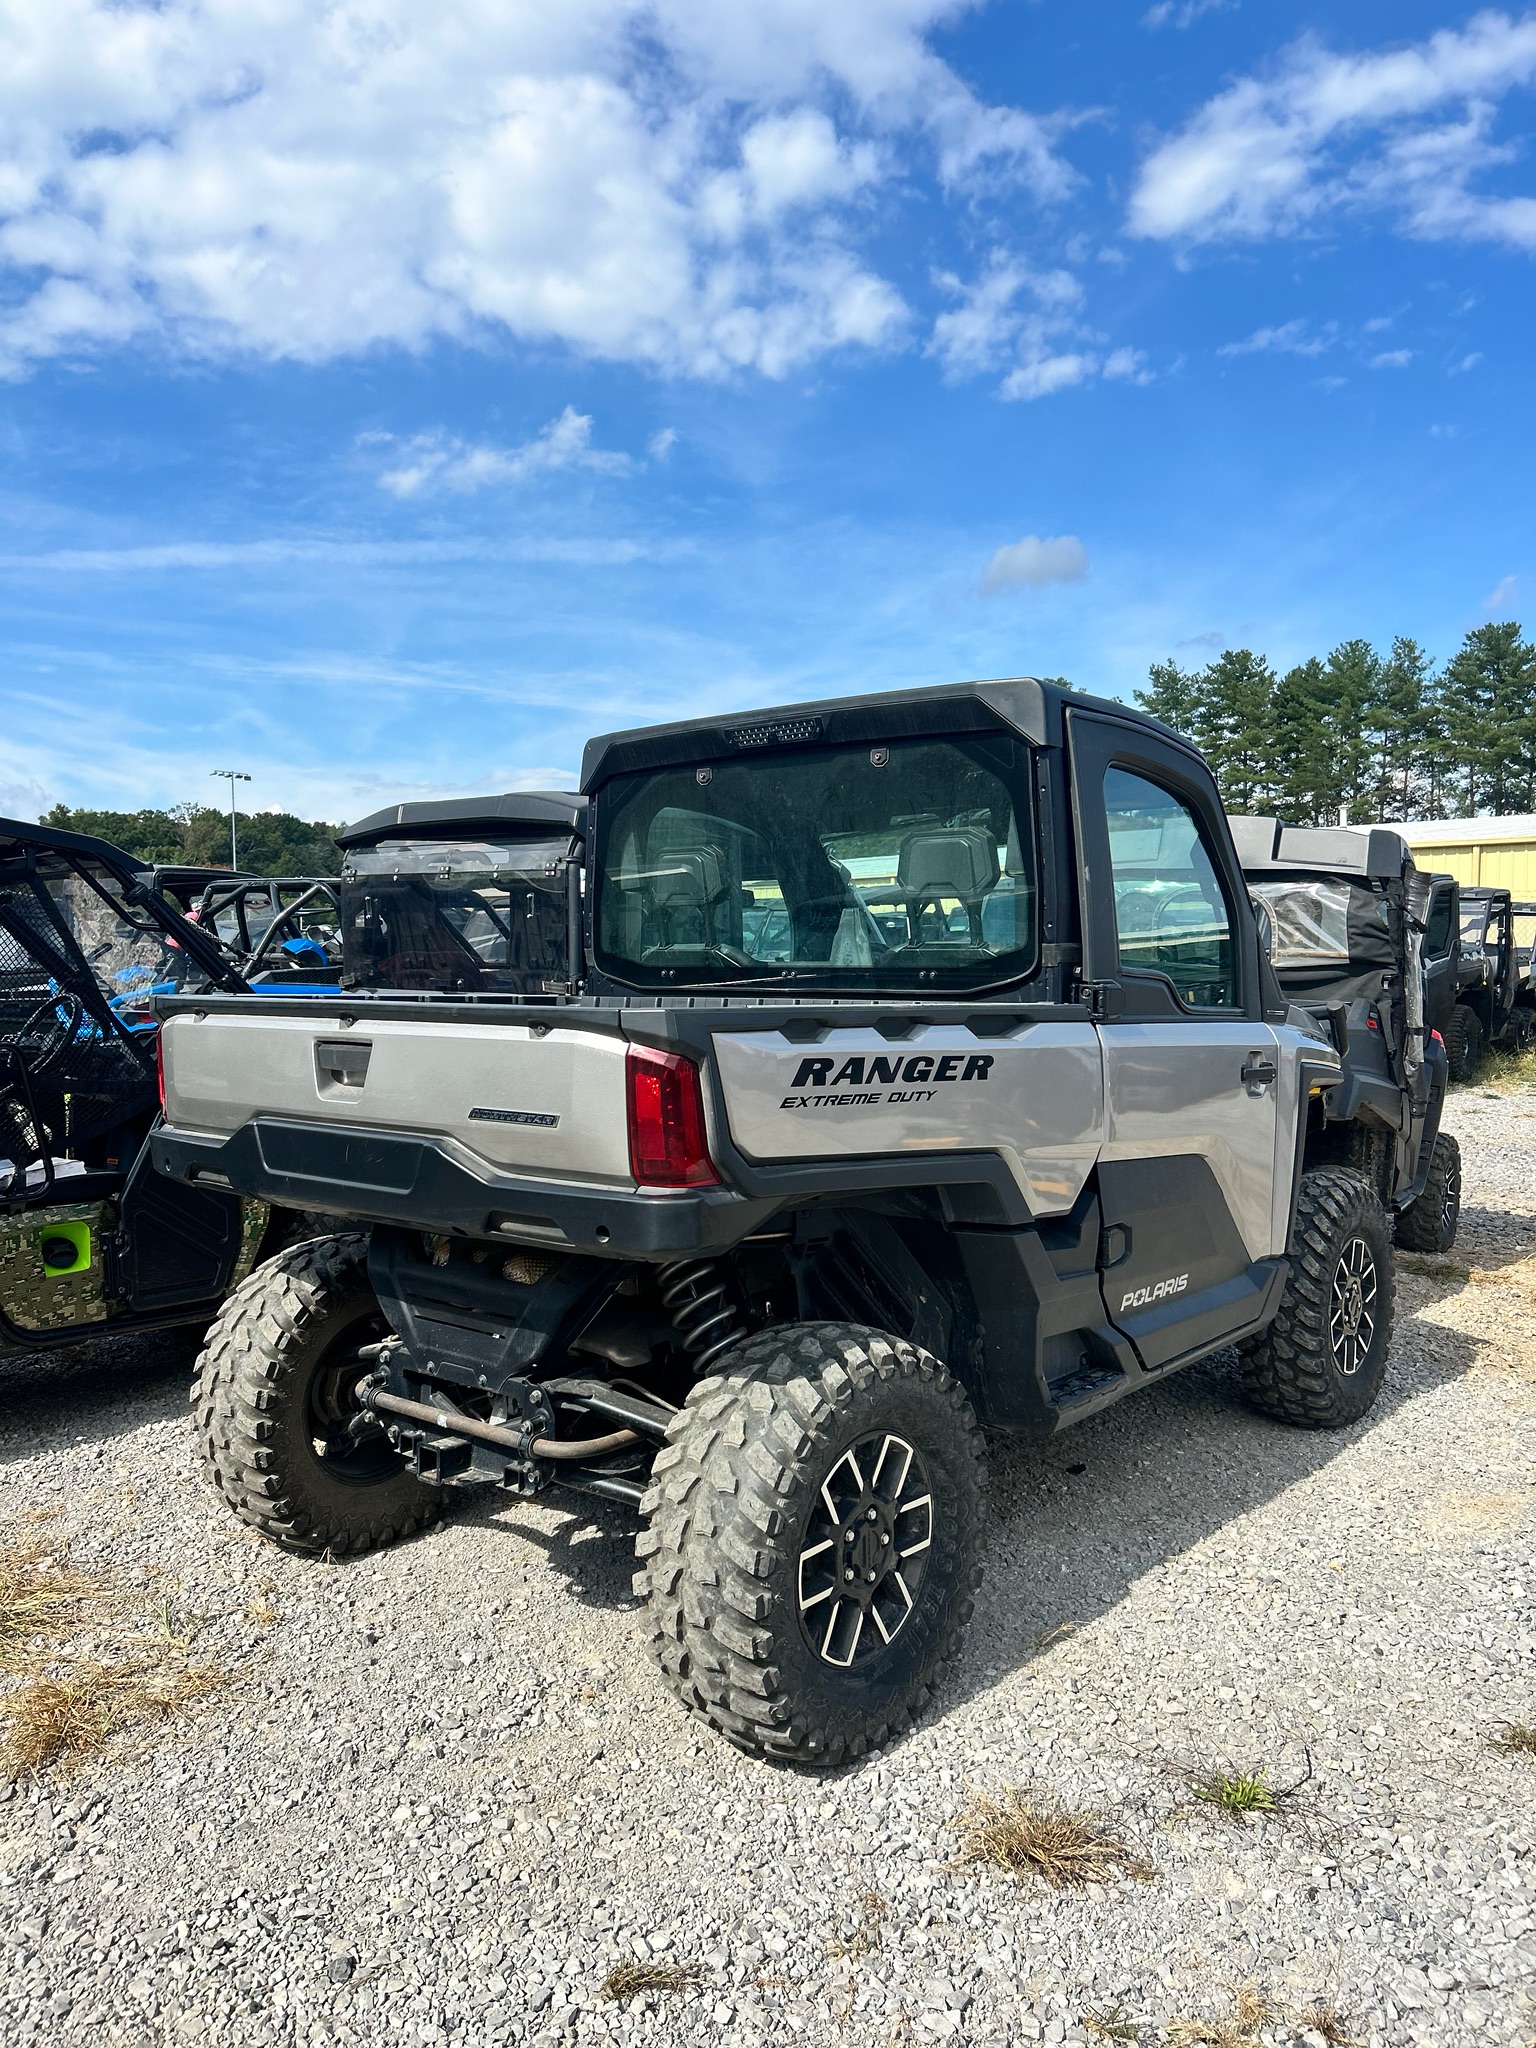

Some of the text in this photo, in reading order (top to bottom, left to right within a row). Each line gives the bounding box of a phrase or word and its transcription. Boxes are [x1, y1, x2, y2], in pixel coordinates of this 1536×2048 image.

[790, 1055, 995, 1088] RANGER
[779, 1090, 938, 1109] EXTREME DUTY
[471, 1108, 555, 1126] NORTHSTAR
[1120, 1273, 1189, 1312] POLARIS
[899, 1482, 959, 1657] CROSS TRAIL
